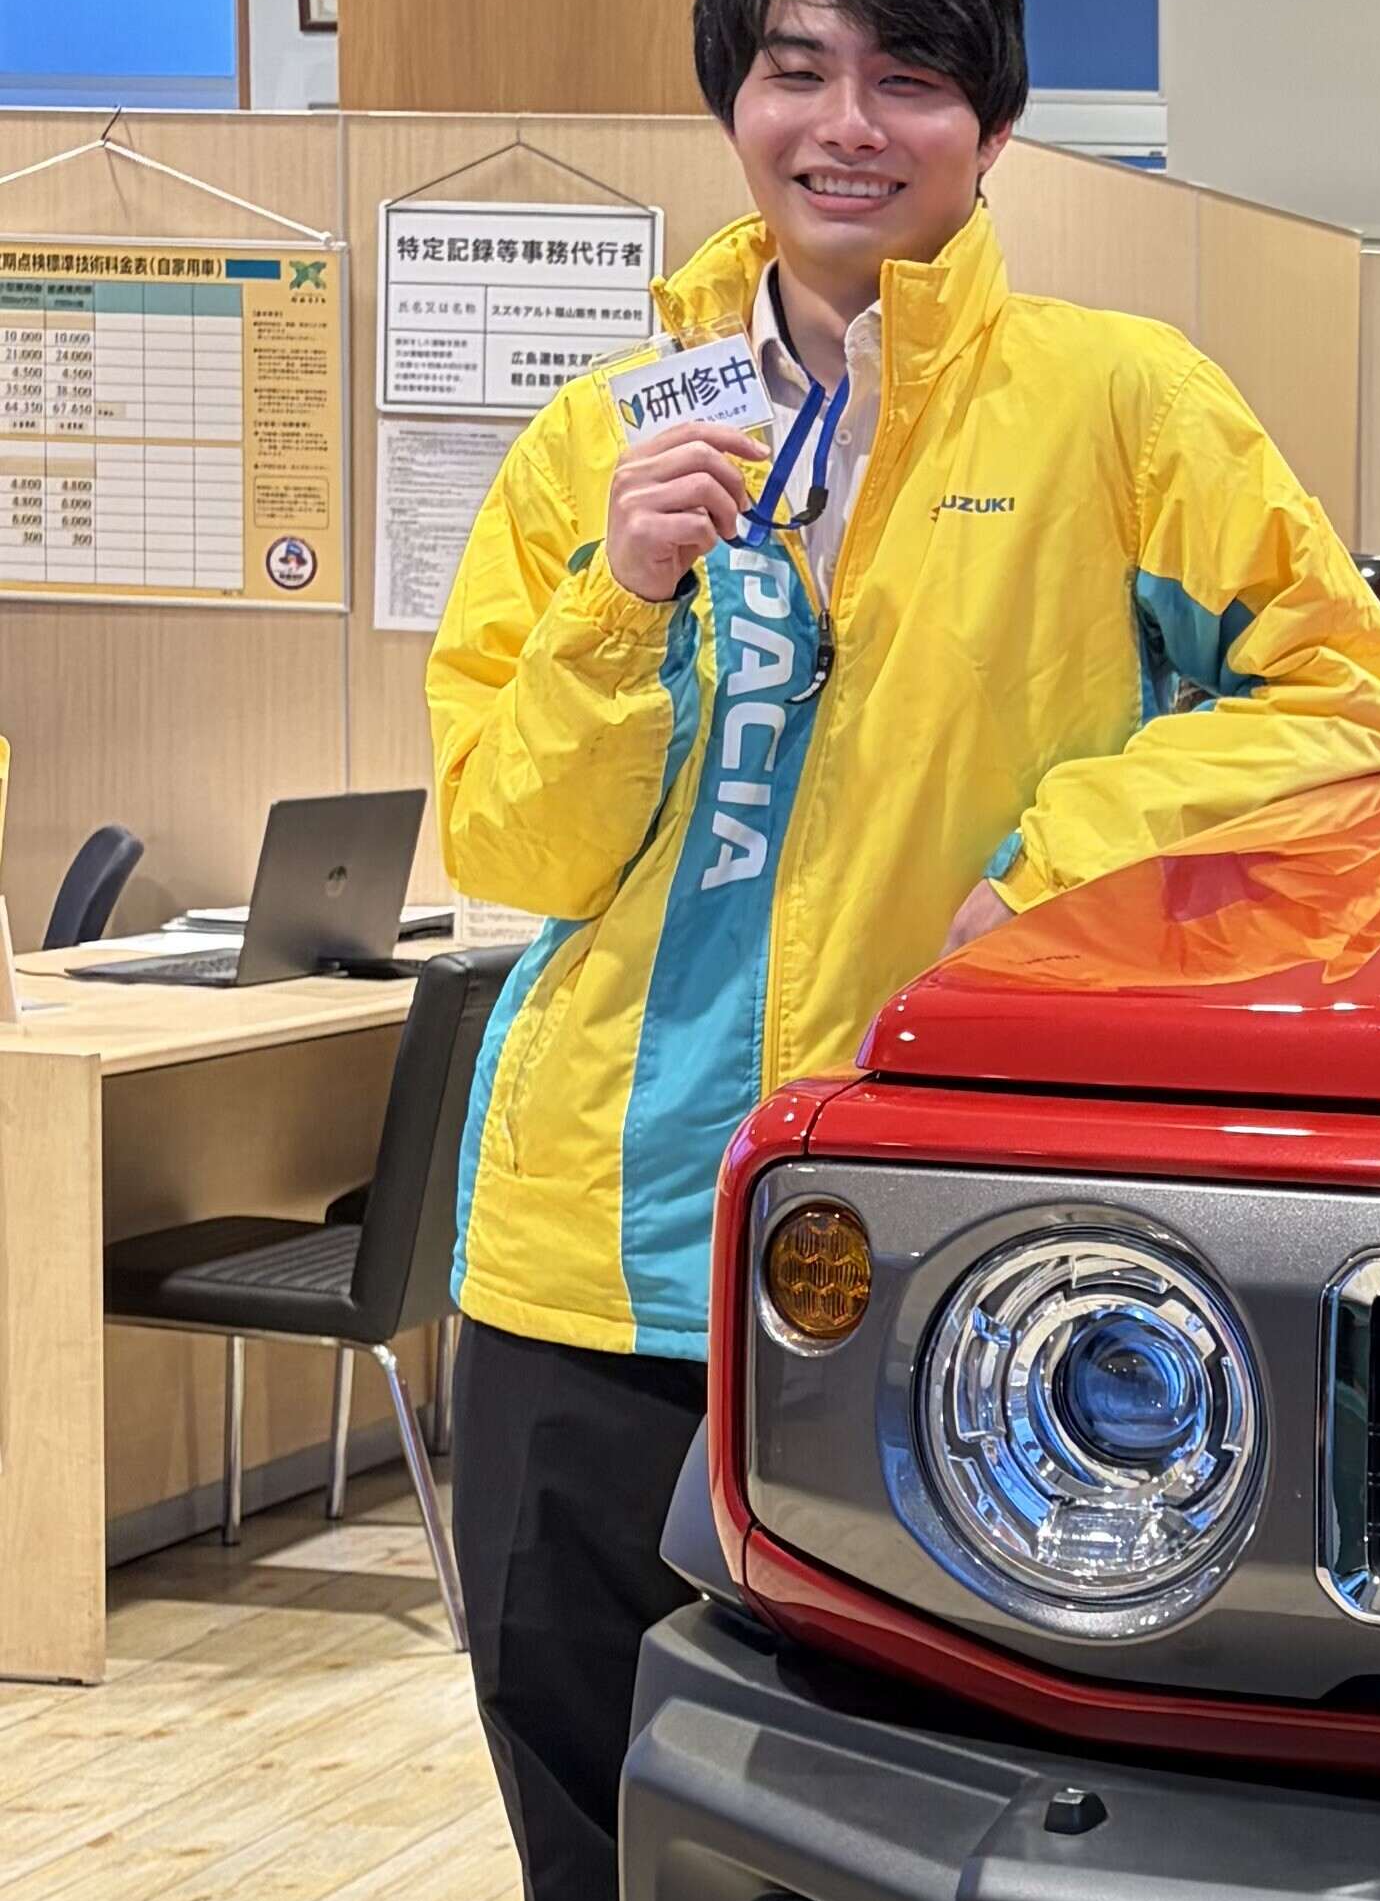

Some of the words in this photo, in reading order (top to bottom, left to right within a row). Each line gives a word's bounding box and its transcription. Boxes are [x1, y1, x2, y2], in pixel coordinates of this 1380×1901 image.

[0, 253, 222, 278] 期点検標準技術料金表(自家用車)
[397, 235, 644, 267] 特定記録等事務代行者
[641, 355, 757, 423] 研修中
[941, 494, 1015, 514] UZUKI
[700, 514, 796, 891] PACIA
